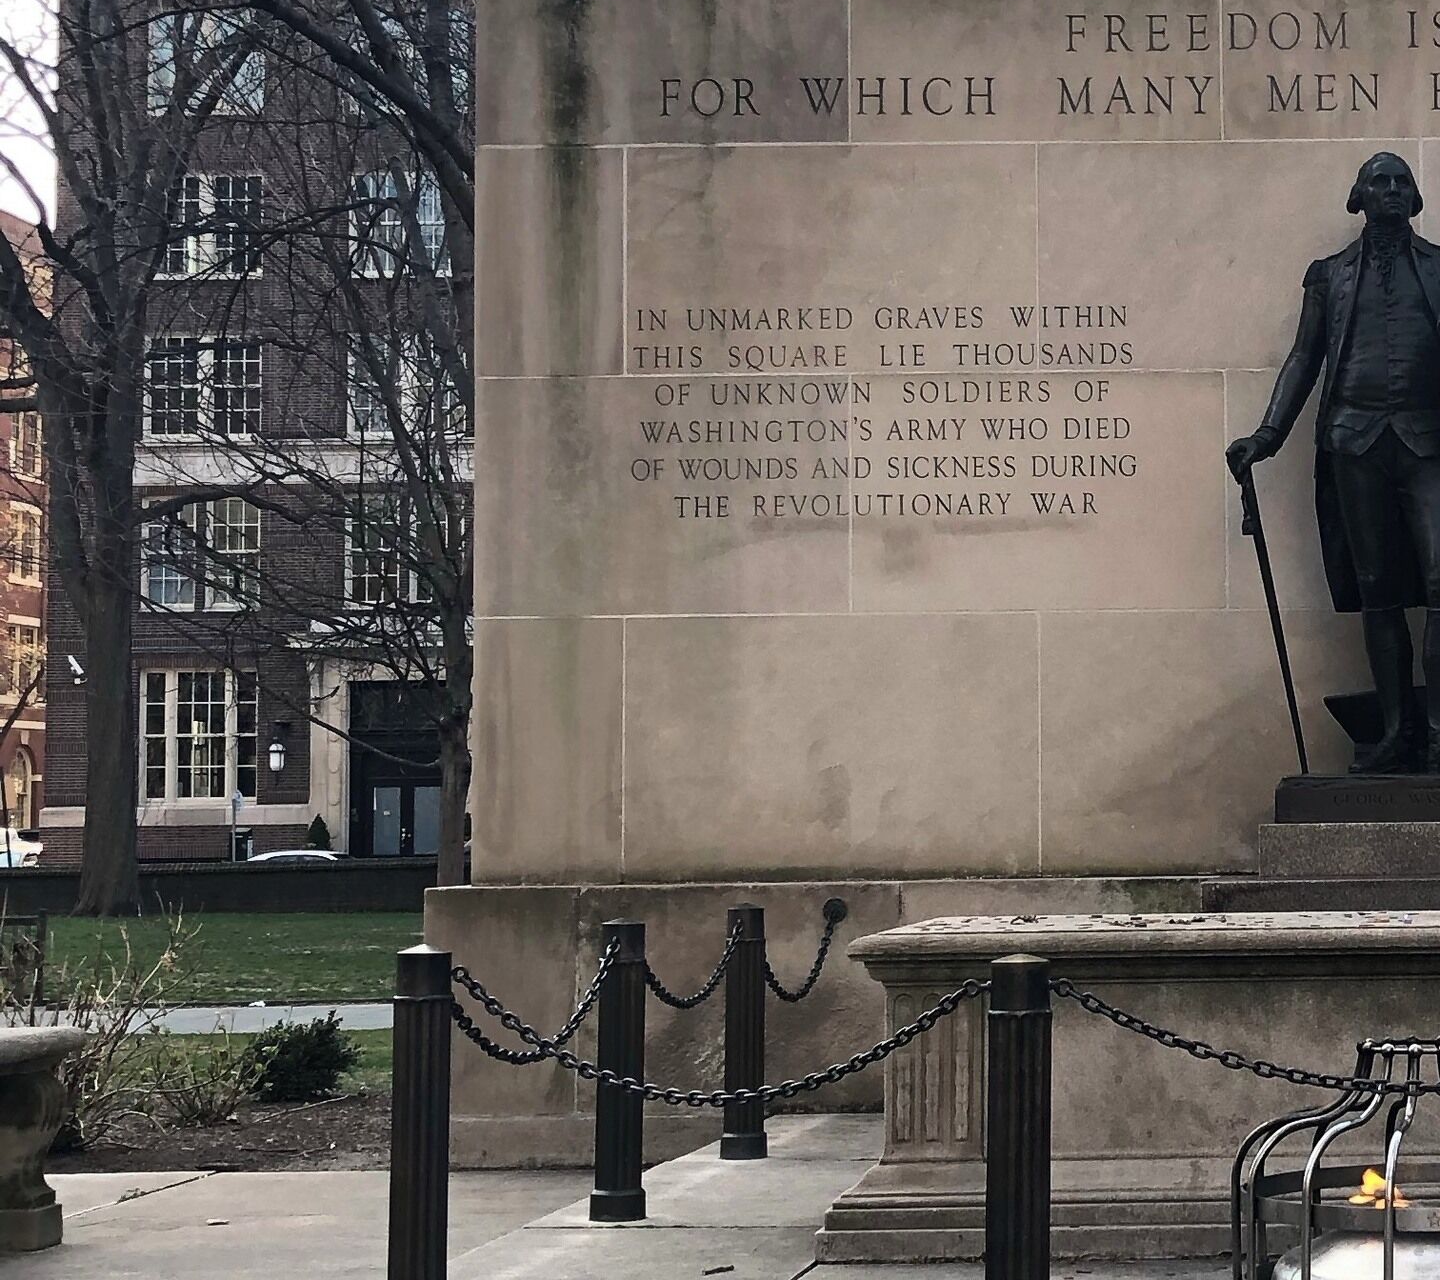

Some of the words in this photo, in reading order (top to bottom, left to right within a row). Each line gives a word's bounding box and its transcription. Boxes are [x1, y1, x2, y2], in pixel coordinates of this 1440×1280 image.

[1066, 11, 1350, 52] FREEDOM
[659, 77, 761, 117] FOR
[799, 76, 996, 116] WHICH
[1057, 73, 1213, 116] MANY
[1266, 72, 1381, 114] MEN
[637, 308, 667, 331] IN
[687, 307, 853, 331] UNMARKED
[874, 306, 984, 329] GRAVES
[1010, 305, 1128, 328] WITHIN
[633, 346, 703, 369] THIS
[728, 344, 848, 371] SQUARE
[879, 344, 926, 367] LIE
[953, 343, 1133, 366] THOUSANDS
[655, 383, 691, 406] OF
[711, 381, 872, 405] UNKNOWN
[903, 381, 1051, 403] SOLDIERS
[1074, 380, 1110, 402] OF
[641, 417, 872, 444] WASHINGTON'S
[886, 418, 967, 441] ARMY
[980, 418, 1048, 440] WHO
[1063, 416, 1131, 439] DIED
[631, 458, 665, 481] OF
[678, 457, 798, 480] WOUNDS
[812, 456, 872, 479] AND
[887, 455, 1017, 479] SICKNESS
[1031, 454, 1138, 478] DURING
[674, 495, 729, 518] THE
[753, 492, 1012, 518] REVOLUTIONARY
[1030, 492, 1098, 514] WAR
